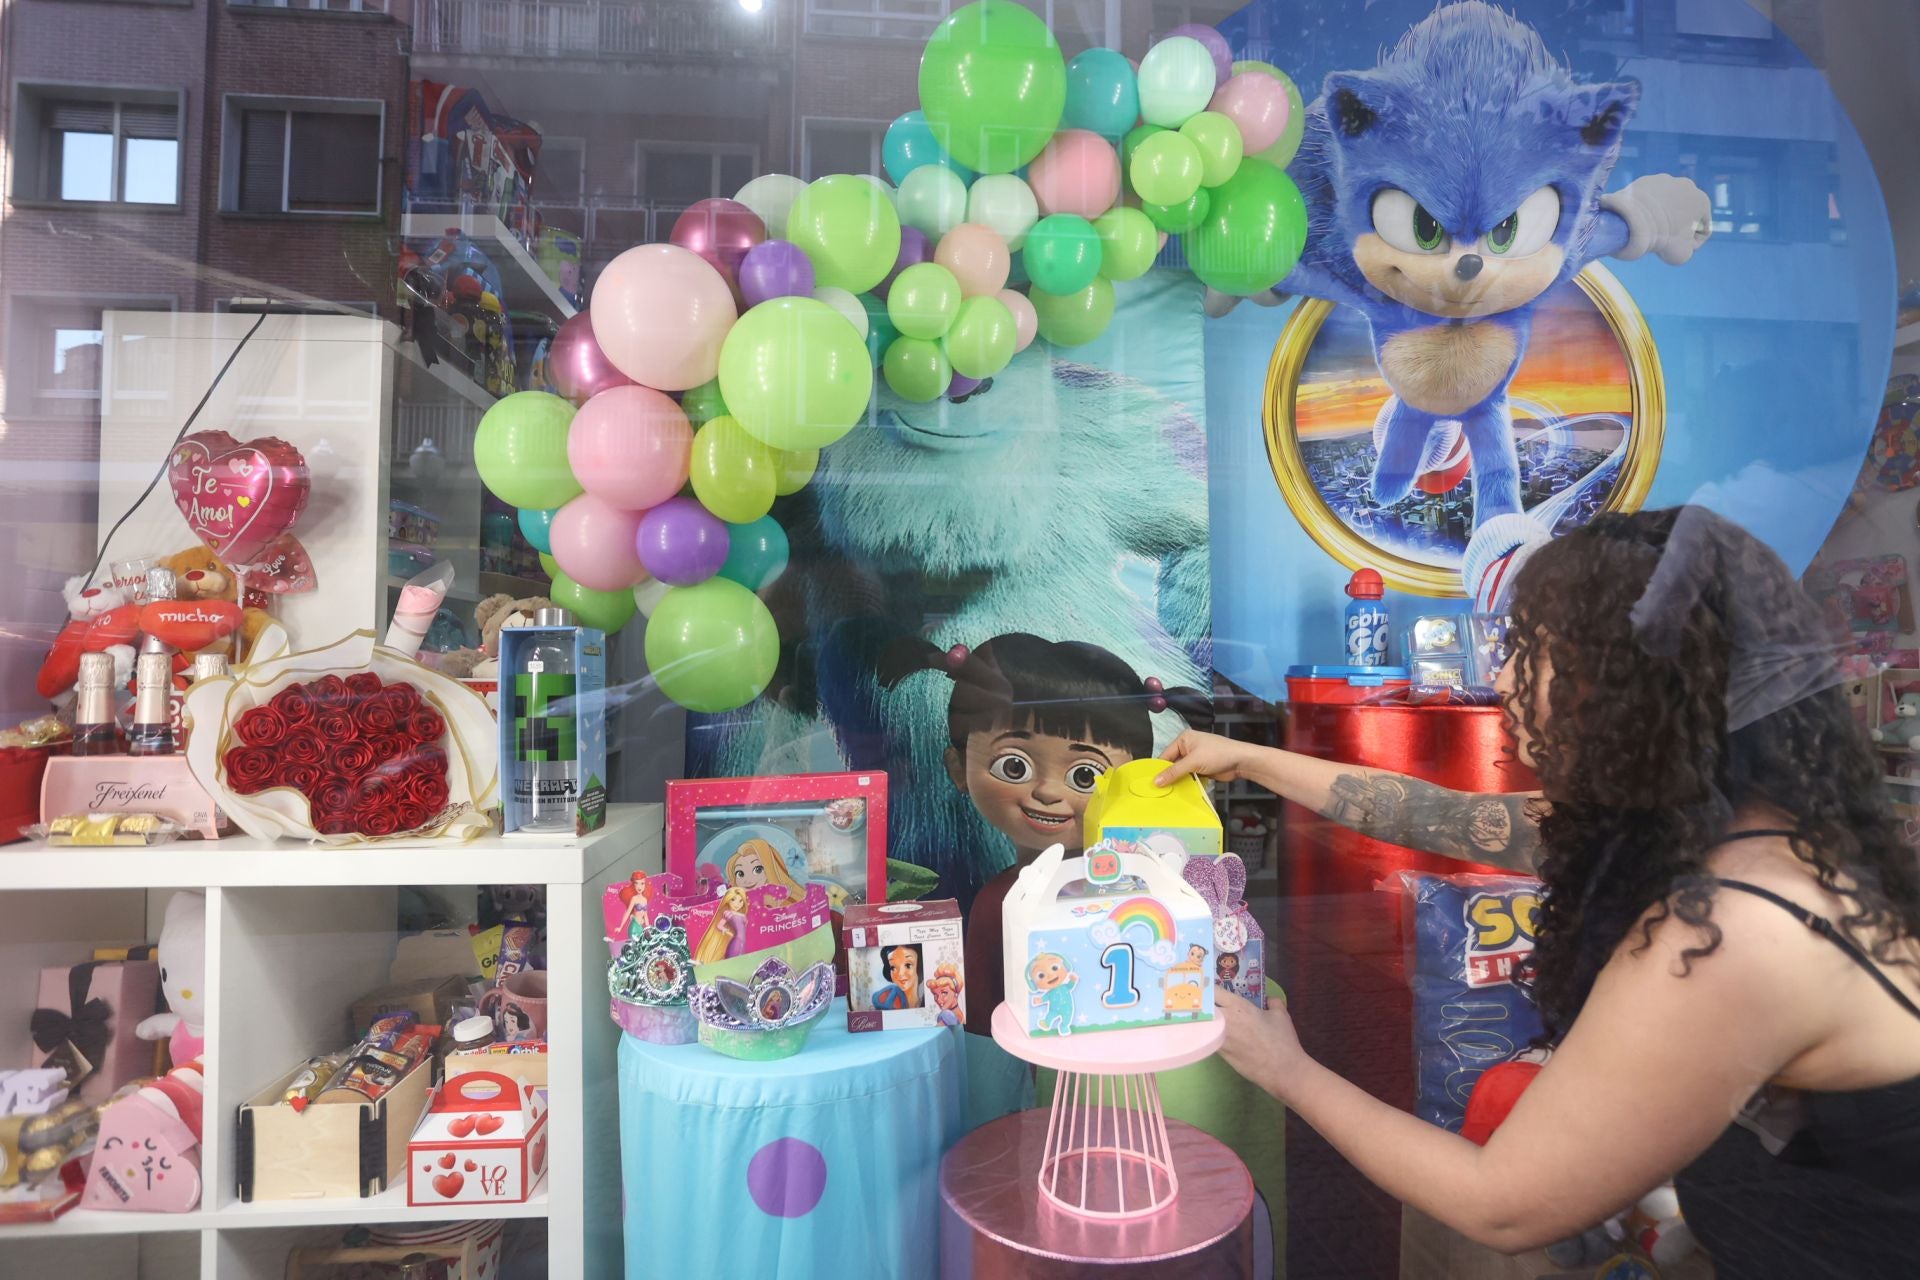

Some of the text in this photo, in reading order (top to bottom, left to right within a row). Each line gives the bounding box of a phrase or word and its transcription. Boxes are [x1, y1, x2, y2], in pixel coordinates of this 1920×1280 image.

[192, 466, 218, 495] Te
[188, 497, 234, 529] Amo!
[262, 553, 287, 577] Love
[158, 608, 224, 623] mucho
[1348, 613, 1389, 629] GOTTA
[1348, 624, 1389, 655] GO
[1423, 670, 1460, 681] SONIC
[88, 781, 168, 809] Freixenet
[759, 916, 807, 935] PRINCESS
[773, 911, 798, 923] Disney
[1101, 942, 1140, 1009] 1
